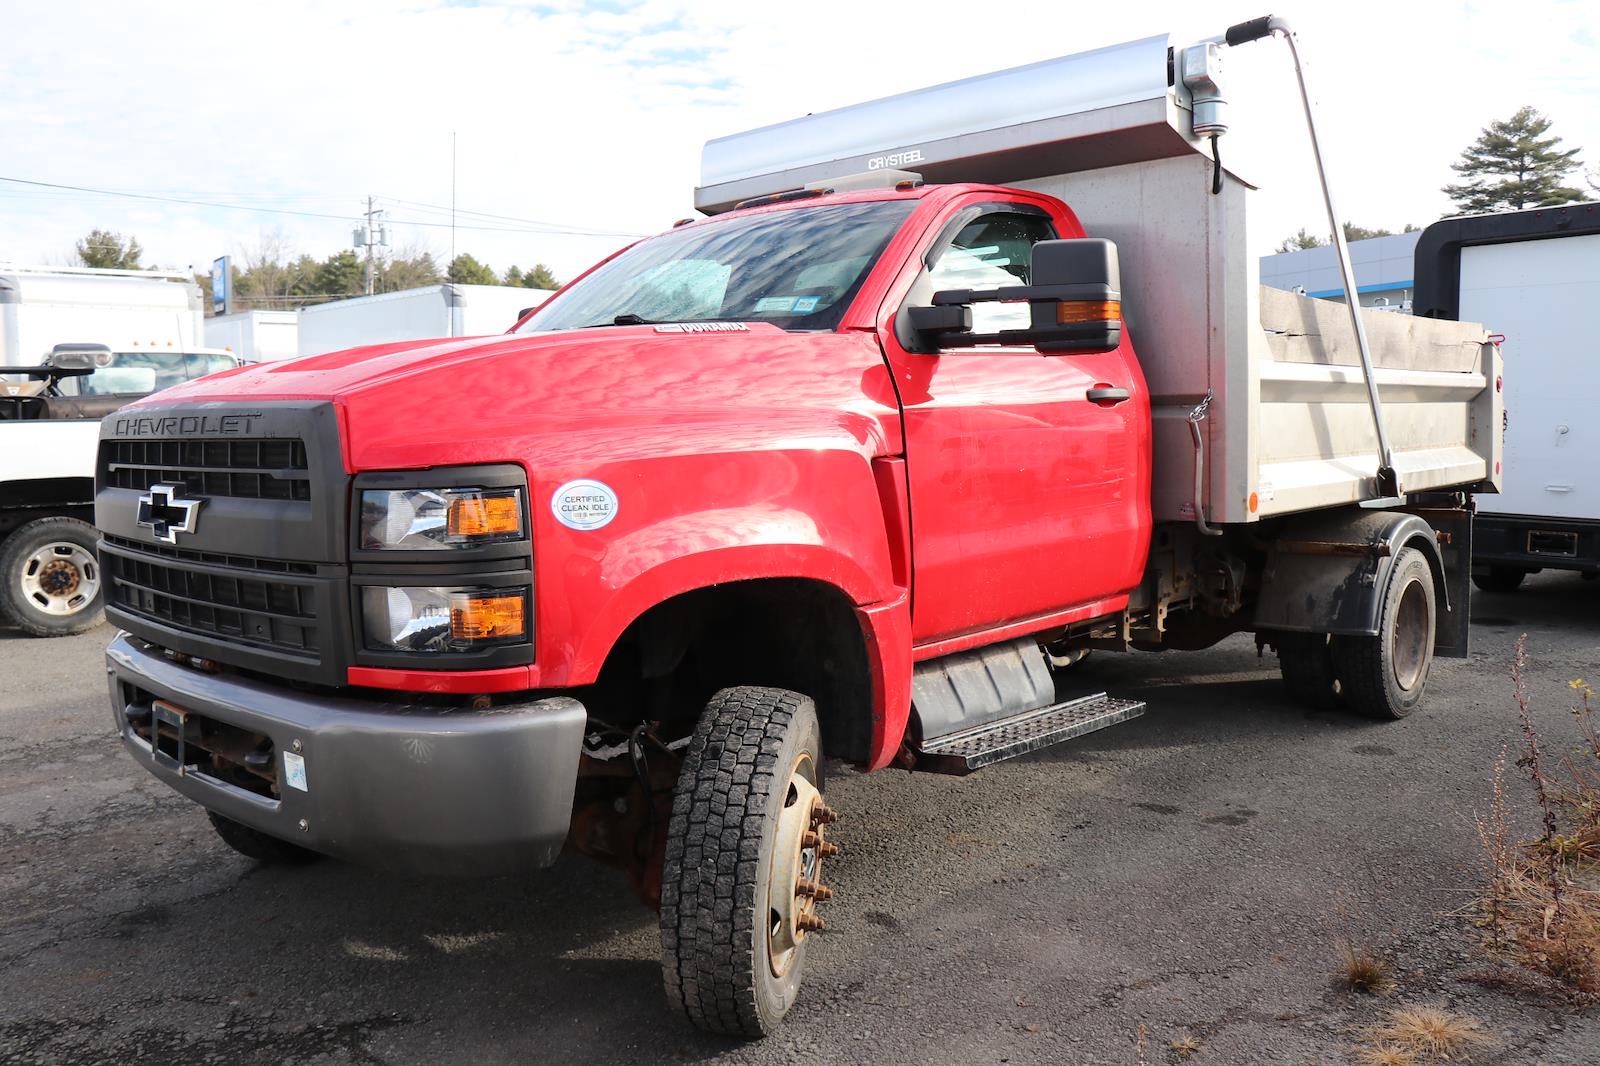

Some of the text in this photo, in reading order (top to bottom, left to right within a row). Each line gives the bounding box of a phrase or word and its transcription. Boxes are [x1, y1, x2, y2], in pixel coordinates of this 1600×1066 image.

[868, 150, 925, 170] CRYSTEEL
[115, 413, 262, 436] CHEVROLET
[564, 495, 605, 503] CERTIFIED
[561, 503, 610, 512] CLEAN IDLE
